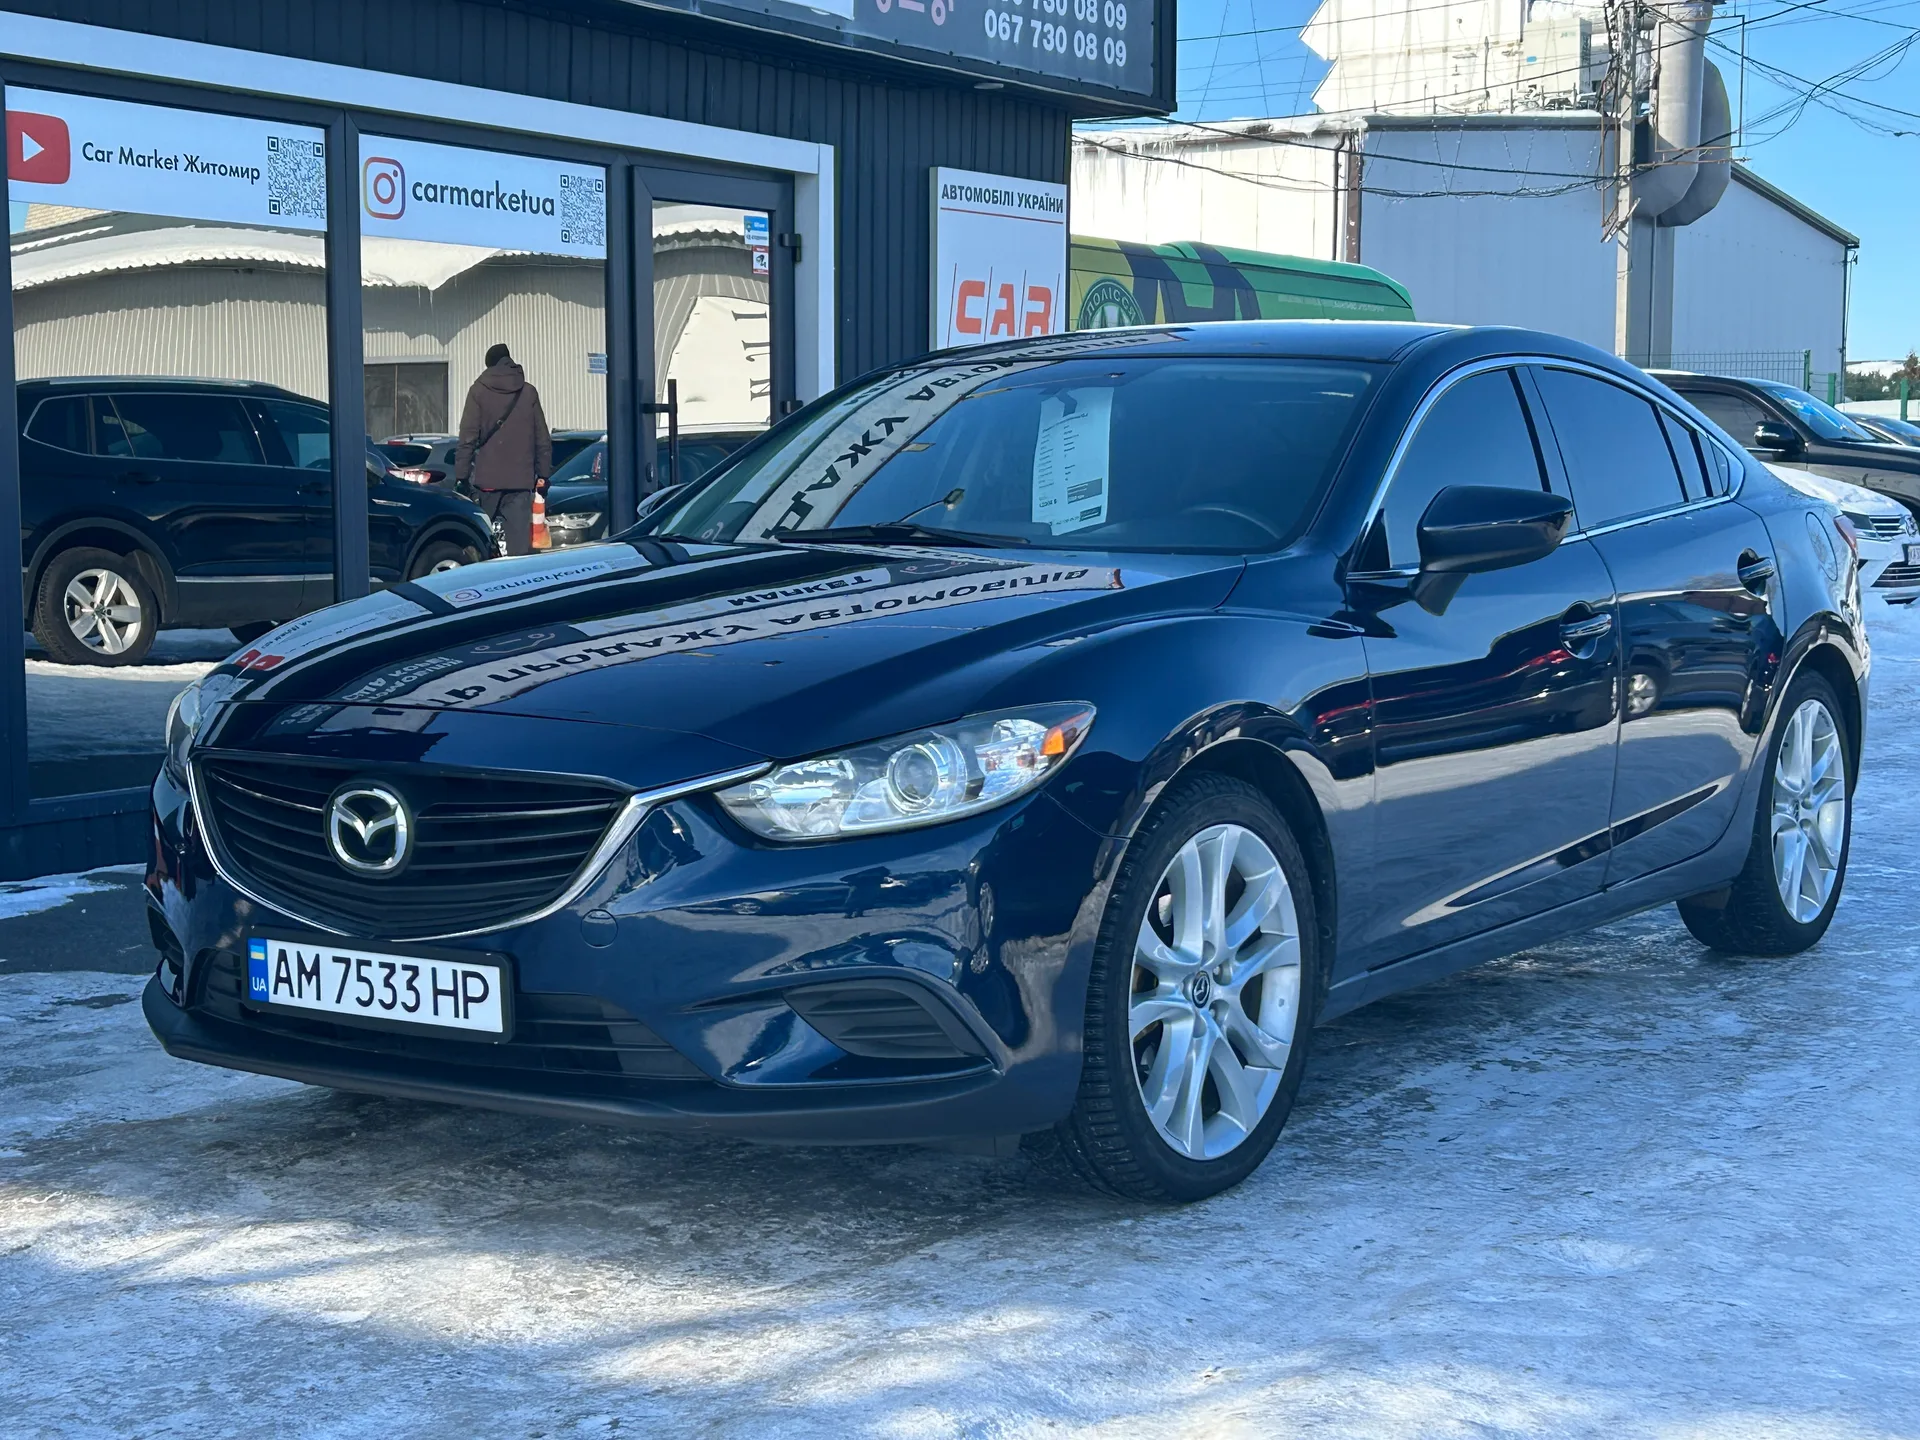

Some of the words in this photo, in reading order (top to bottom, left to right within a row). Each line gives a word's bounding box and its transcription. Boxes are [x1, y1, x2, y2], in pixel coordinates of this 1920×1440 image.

[1074, 0, 1099, 24] 08
[1103, 0, 1127, 31] 09
[984, 9, 1023, 44] 067
[1030, 19, 1067, 54] 730
[1073, 30, 1098, 60] 08
[1103, 37, 1127, 67] 09
[82, 142, 113, 164] Car
[118, 147, 179, 172] Market
[183, 154, 261, 185] Житомир
[411, 181, 556, 217] carmarketua
[941, 183, 1014, 208] АВТОМОБІЛІ
[1017, 190, 1064, 214] УКРАЇНИ
[956, 279, 1052, 337] CAR
[252, 977, 267, 992] UA
[273, 948, 321, 1001] AM
[331, 955, 421, 1013] 7533
[431, 967, 490, 1019] HP
